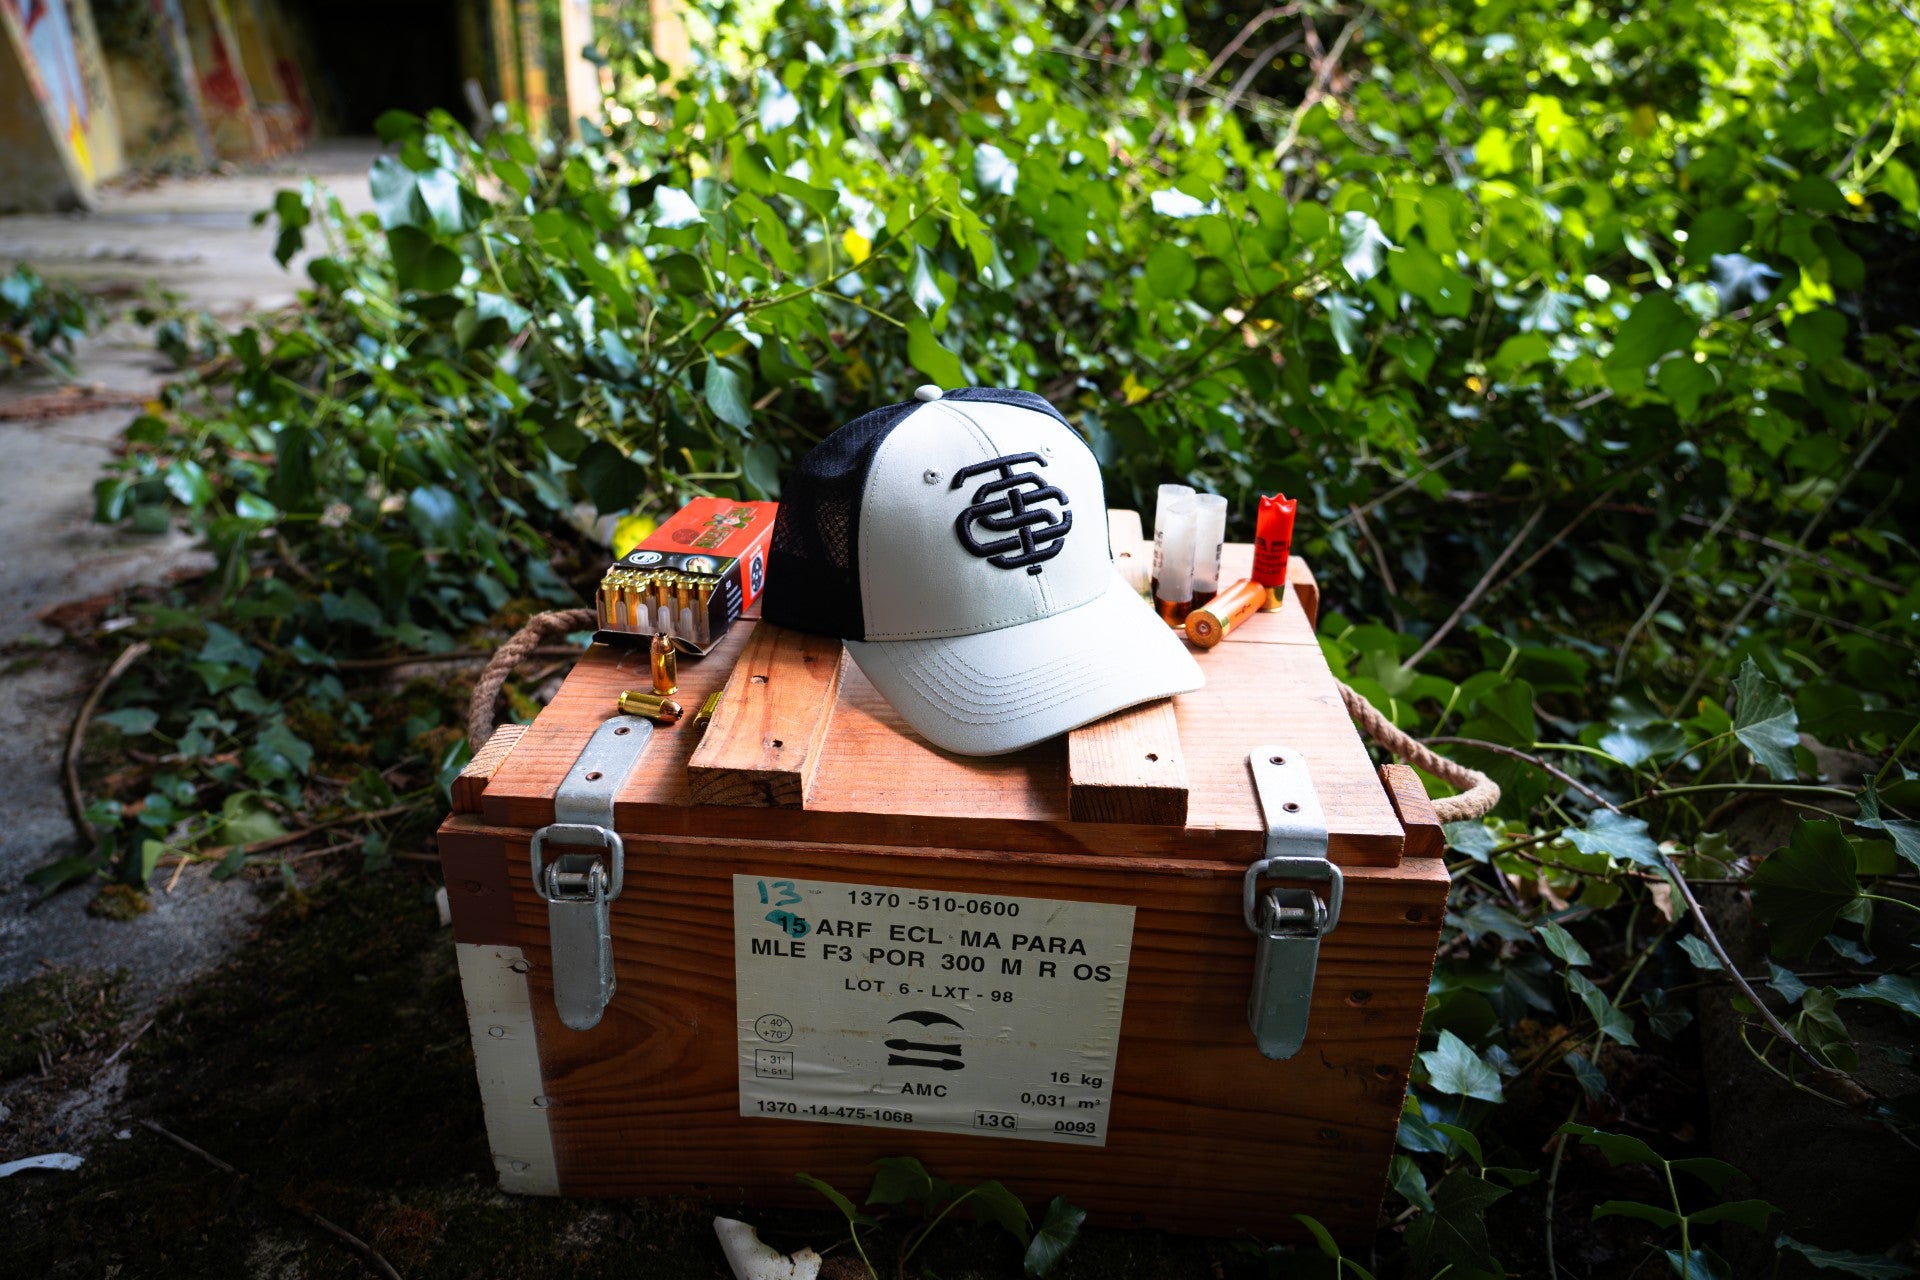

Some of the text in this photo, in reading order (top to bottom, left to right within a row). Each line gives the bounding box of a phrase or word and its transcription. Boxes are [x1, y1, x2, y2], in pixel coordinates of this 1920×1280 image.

[757, 879, 803, 907] 13
[815, 918, 872, 938] ARF
[889, 925, 943, 945] ECL
[960, 930, 1001, 950] MA
[1011, 934, 1087, 956] PARA
[751, 938, 1112, 982] MLE F3 POR 300 M R OS
[845, 978, 886, 993] LOT
[899, 983, 910, 995] 6
[931, 985, 970, 1000] LXT
[990, 990, 1014, 1003] 98
[901, 1082, 948, 1098] AMC
[1050, 1071, 1103, 1089] 16 kg
[1020, 1092, 1066, 1108] 0,031
[1054, 1120, 1096, 1134] 0093
